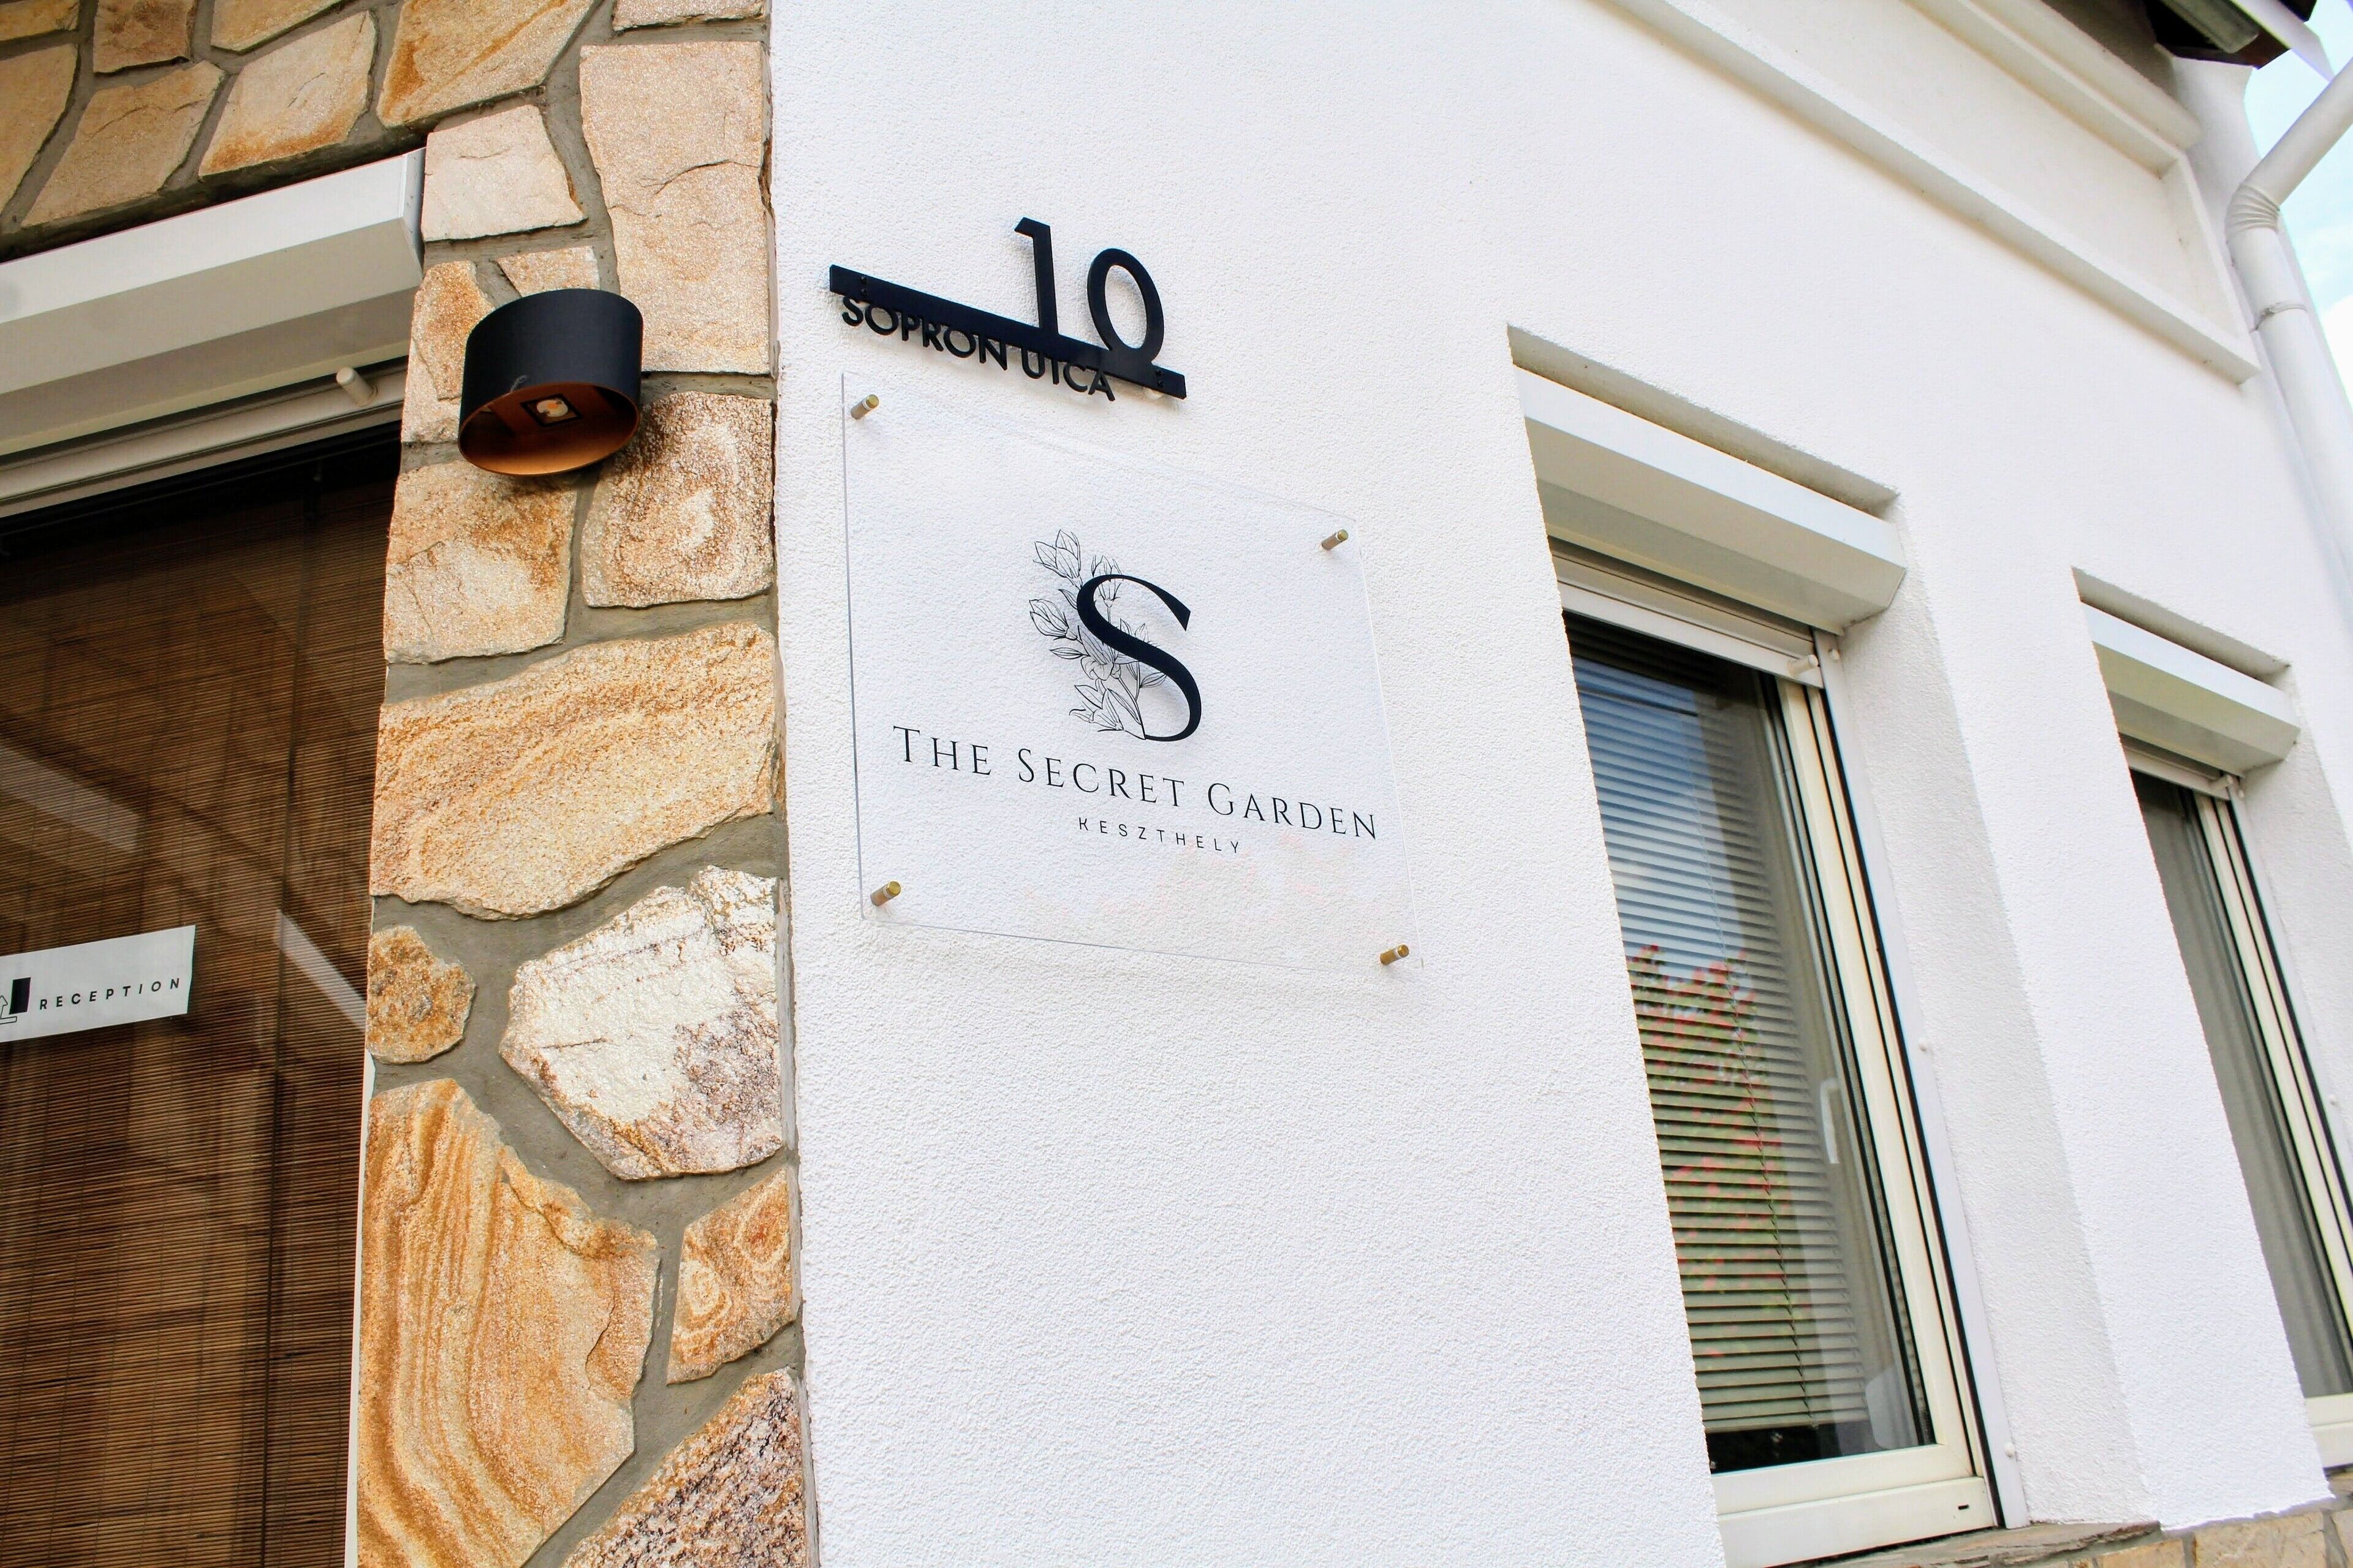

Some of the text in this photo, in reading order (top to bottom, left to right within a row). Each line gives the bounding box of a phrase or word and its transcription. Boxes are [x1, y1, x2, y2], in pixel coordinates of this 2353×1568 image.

[1014, 216, 1165, 366] 10
[841, 295, 1008, 371] SOPRON
[1076, 574, 1202, 742] S
[1078, 816, 1239, 854] KESZTHELY
[39, 977, 180, 1010] RECEPTION
